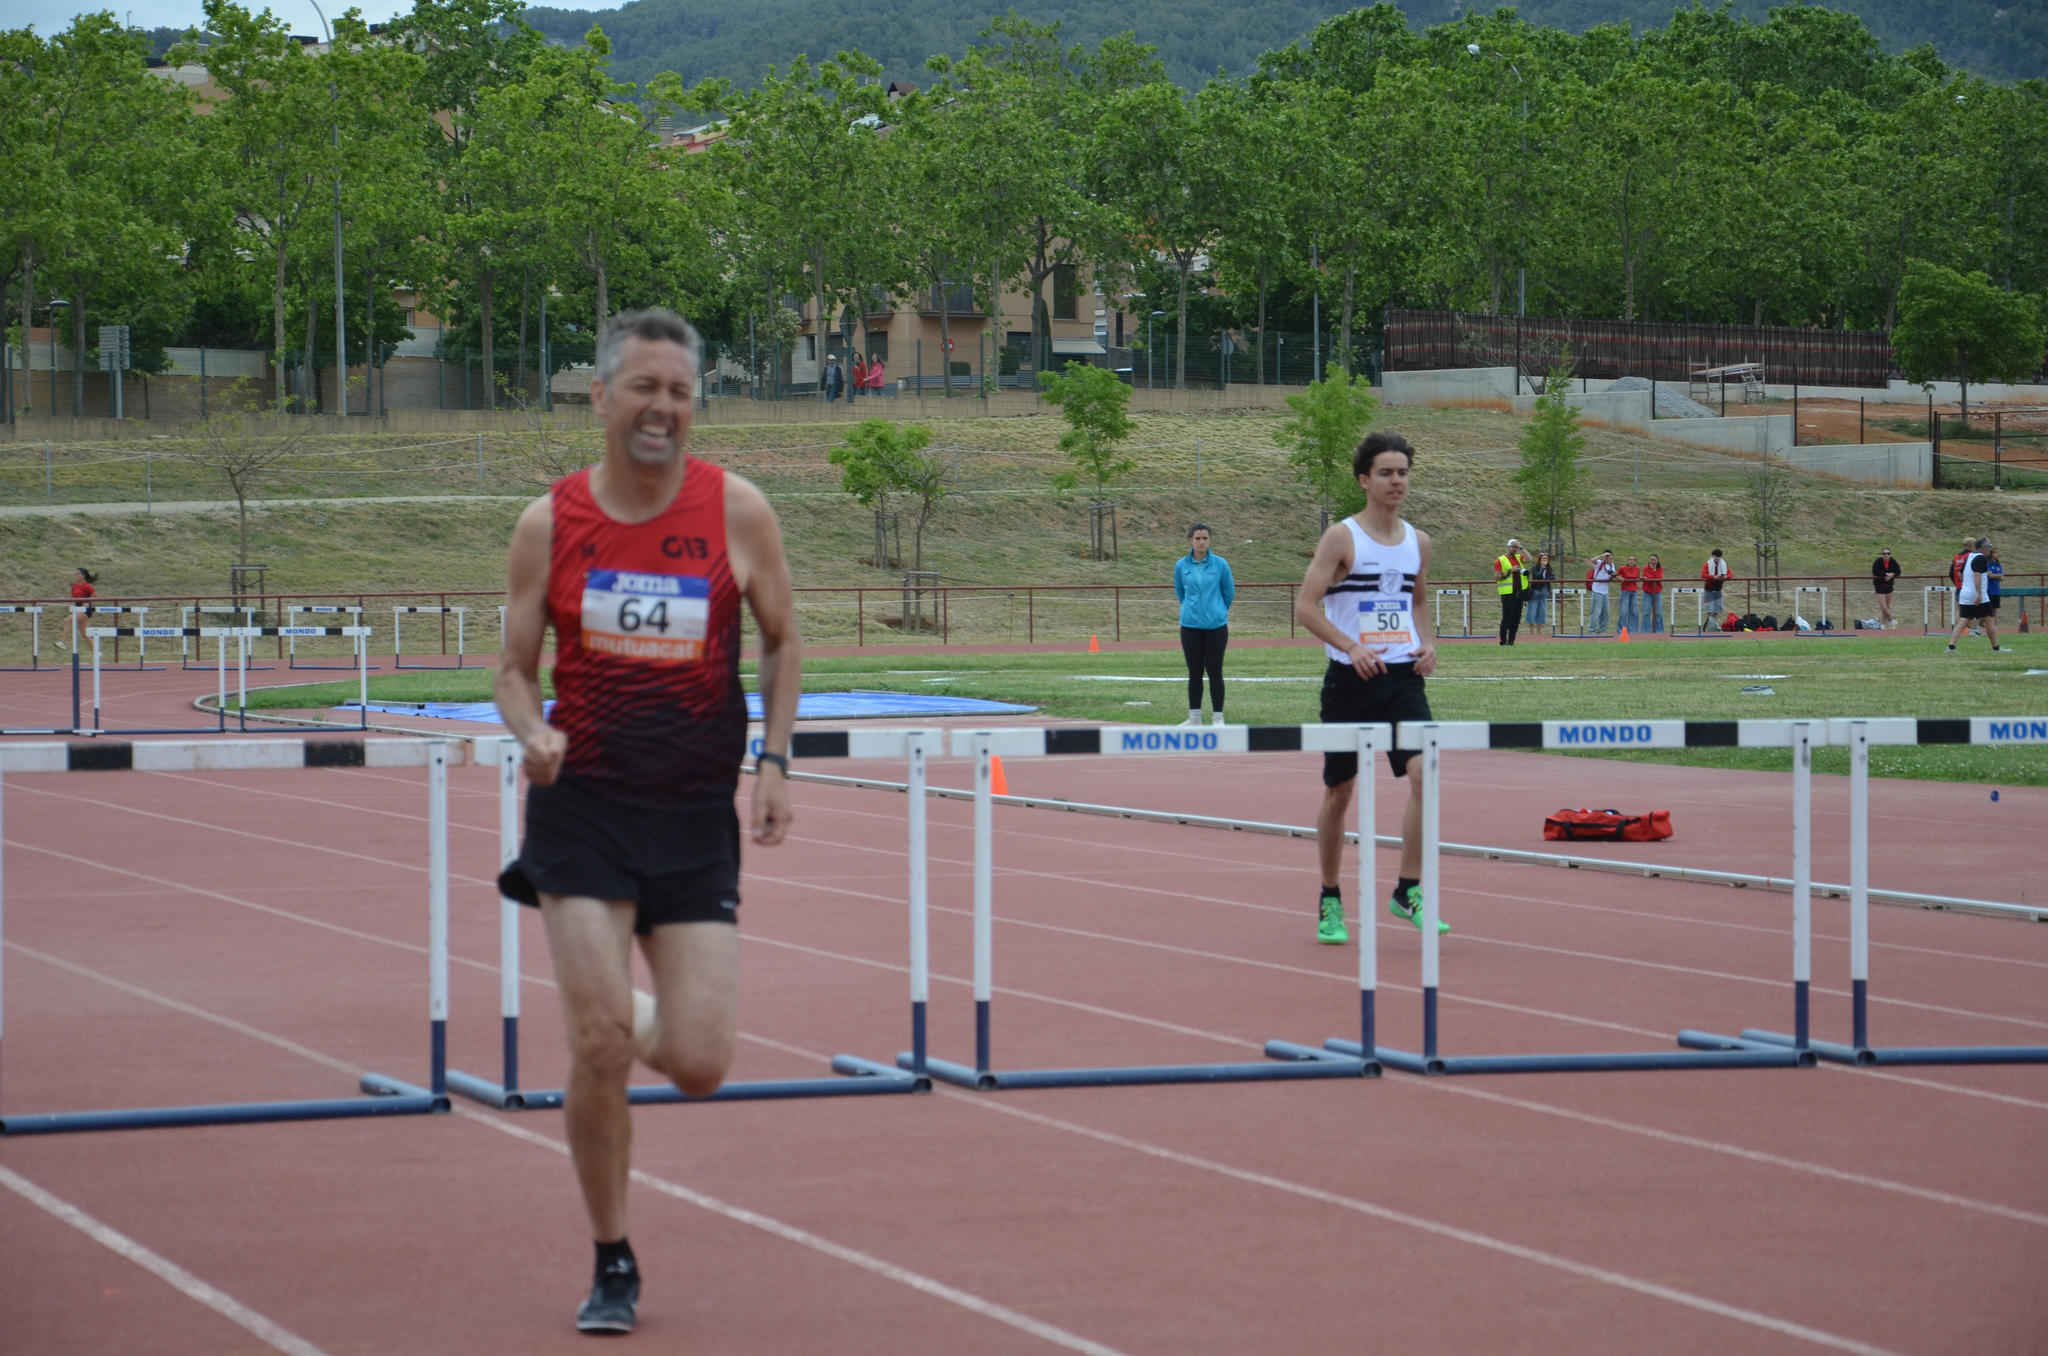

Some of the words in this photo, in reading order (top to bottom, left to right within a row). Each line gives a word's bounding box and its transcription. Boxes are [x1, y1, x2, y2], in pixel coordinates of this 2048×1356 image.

[618, 598, 670, 634] 64
[1377, 612, 1400, 631] 50
[1122, 732, 1218, 751] MONDO
[1558, 725, 1653, 744] MONDO
